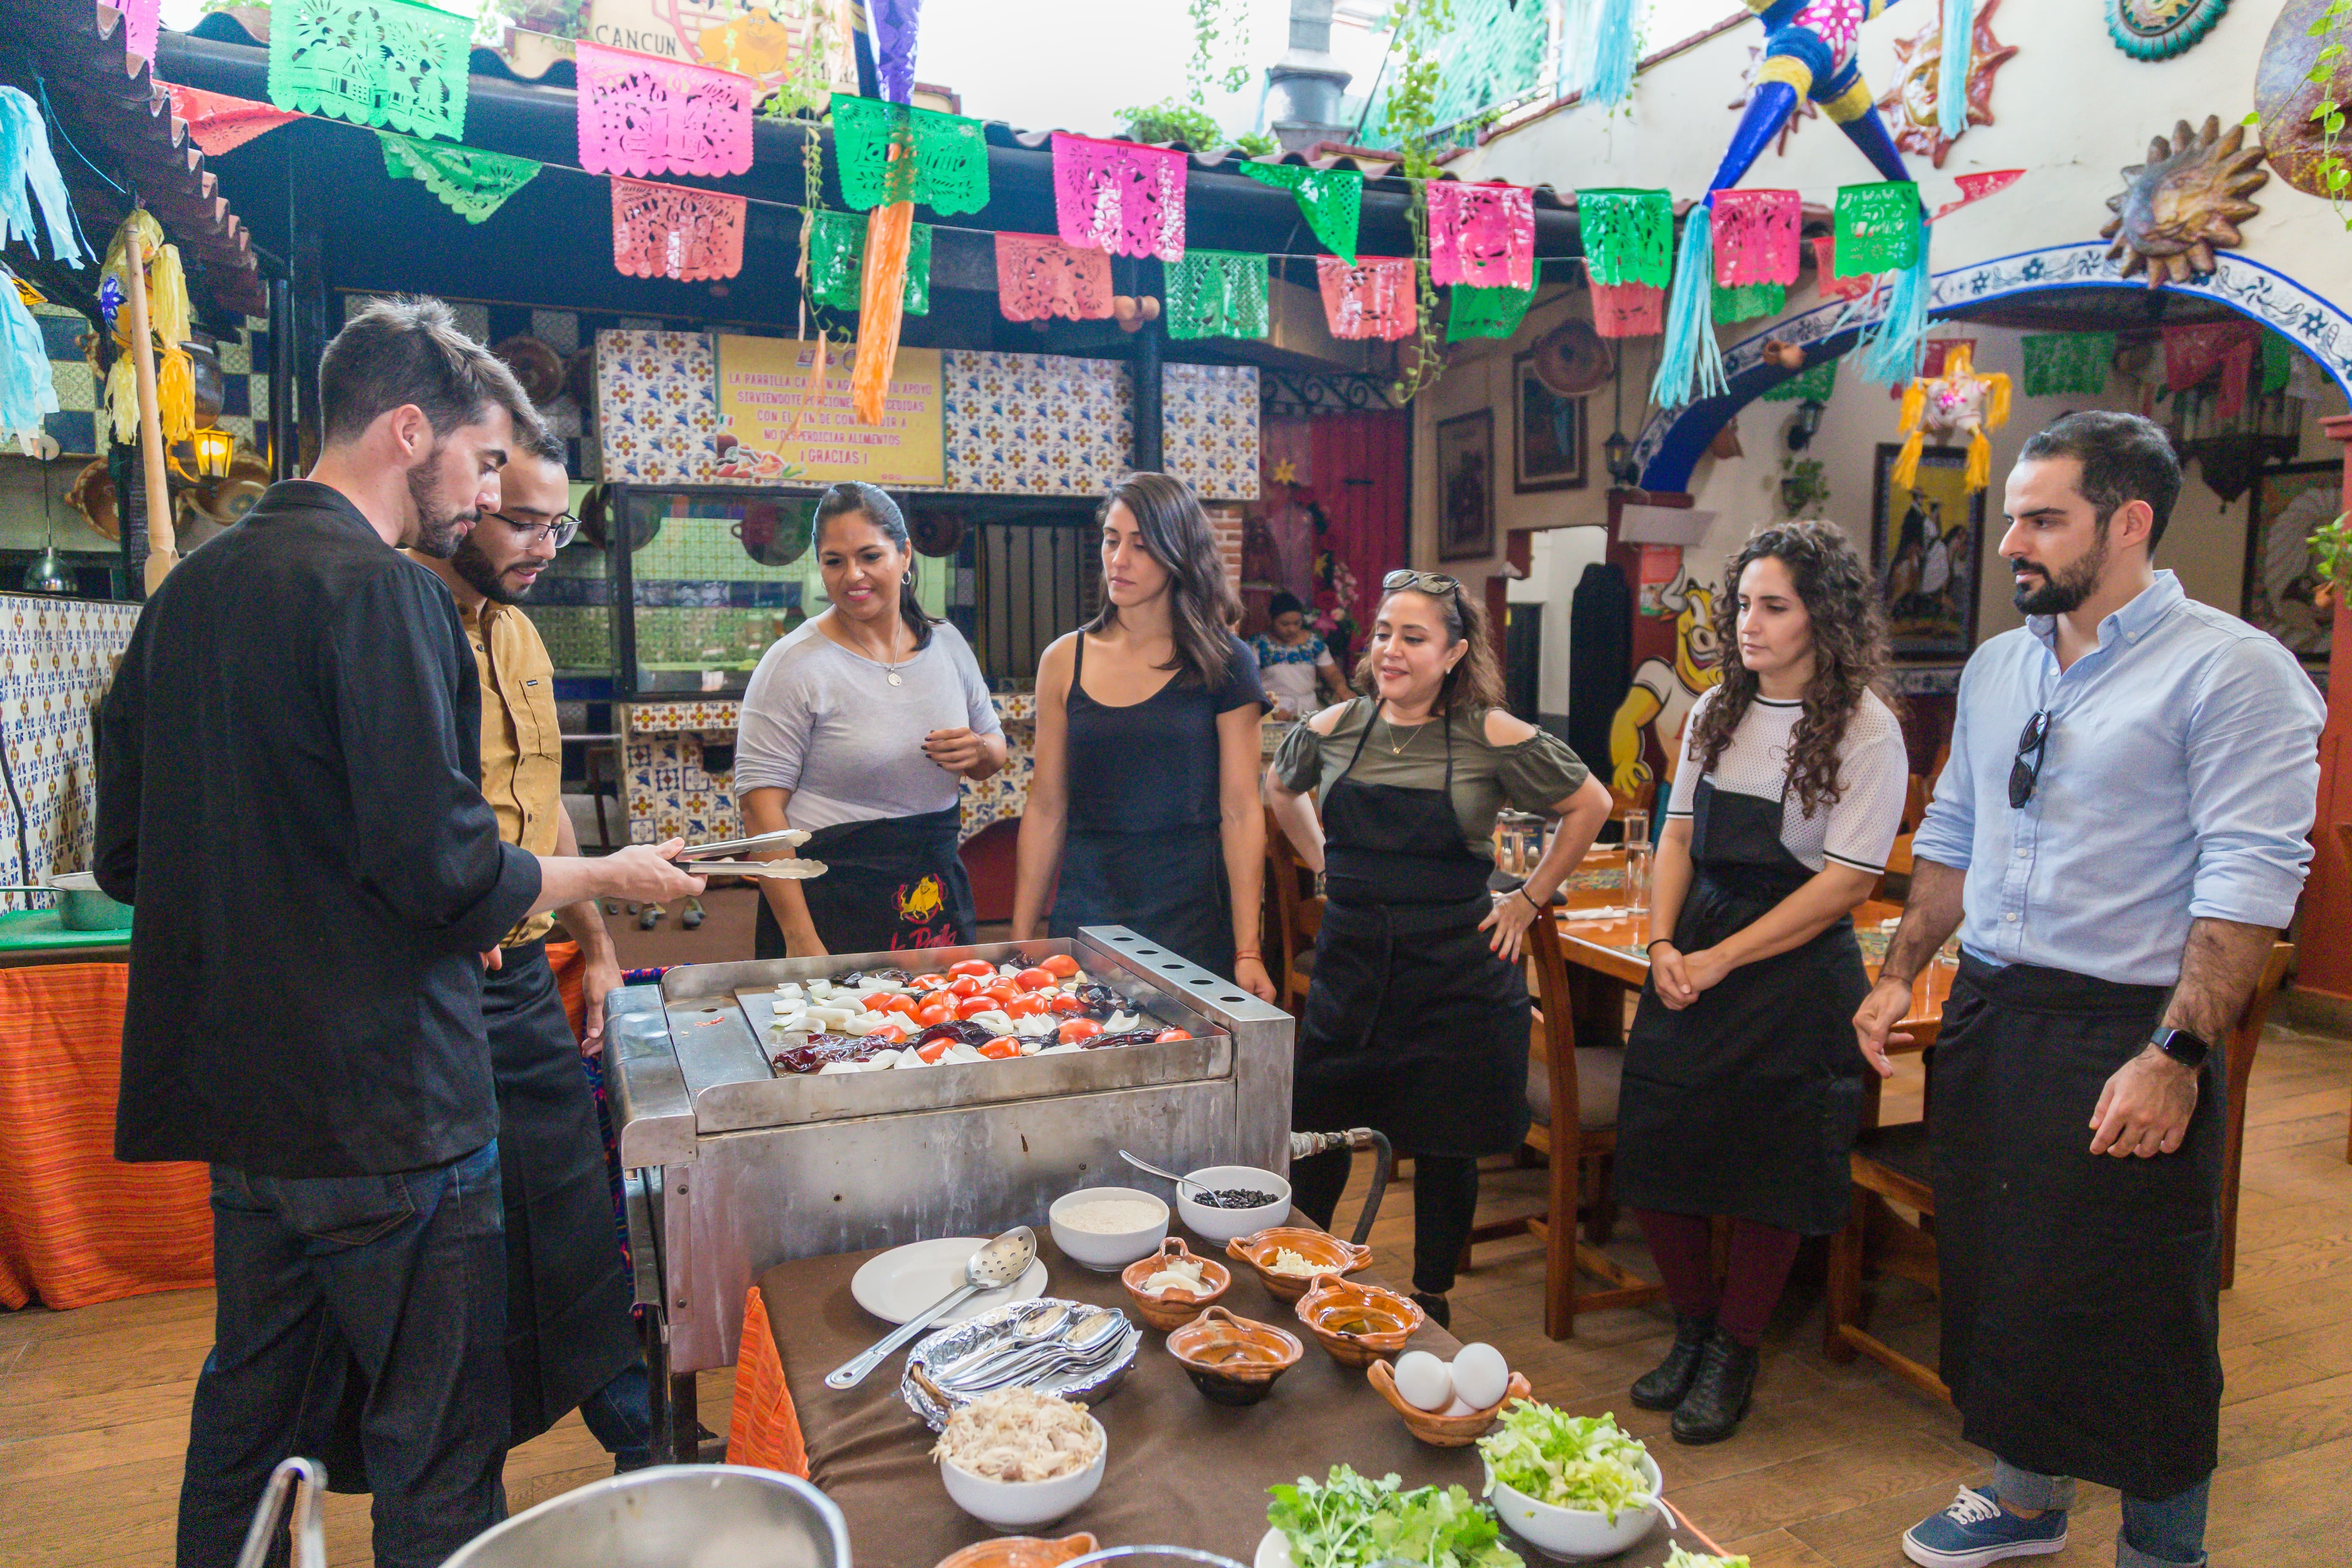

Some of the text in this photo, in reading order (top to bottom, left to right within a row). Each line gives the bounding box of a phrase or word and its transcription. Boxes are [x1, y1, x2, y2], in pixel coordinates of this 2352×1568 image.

[596, 24, 676, 56] CANCUN
[729, 372, 740, 384] LA
[745, 374, 790, 386] PARRILLA
[903, 383, 932, 395] APOYO
[737, 389, 801, 405] SIRVIÉNDOTE
[757, 410, 777, 421] CON
[782, 411, 792, 422] EL
[820, 413, 830, 423] DE
[901, 417, 906, 427] A
[764, 429, 777, 440] NO
[848, 433, 900, 445] ALIMENTOS
[808, 448, 859, 464] GRACIAS
